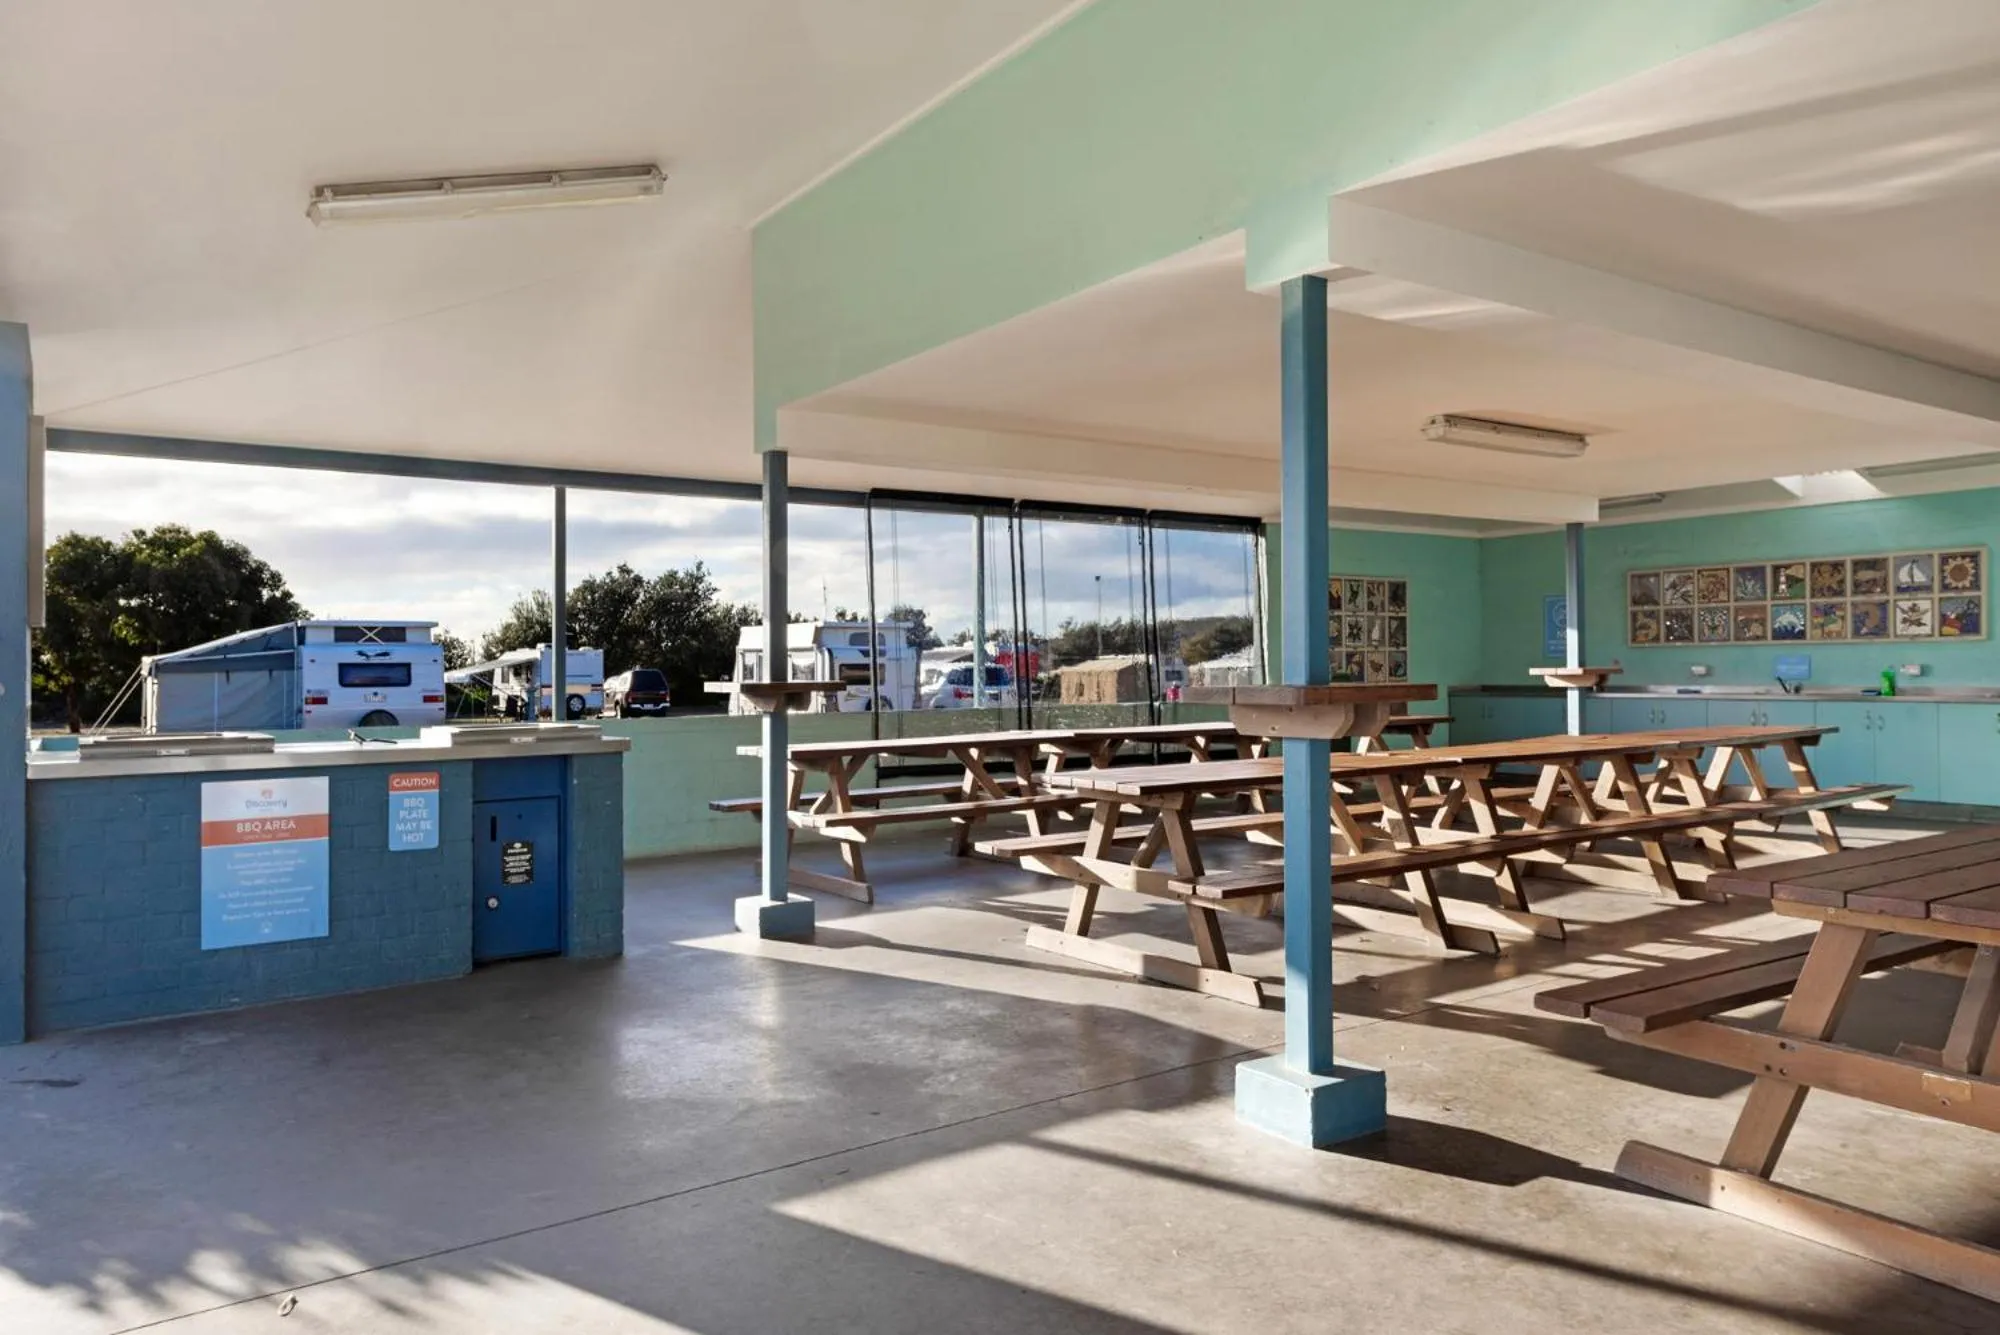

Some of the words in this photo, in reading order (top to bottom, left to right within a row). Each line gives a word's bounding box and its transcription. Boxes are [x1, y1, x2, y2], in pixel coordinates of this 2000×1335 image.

[393, 777, 436, 787] CAUTION
[403, 797, 425, 808] BBQ
[399, 809, 429, 820] PLATE
[236, 822, 261, 833] BBQ
[264, 819, 296, 831] AREA
[395, 821, 417, 832] MAY
[419, 820, 433, 830] BE
[402, 832, 425, 843] HOT
